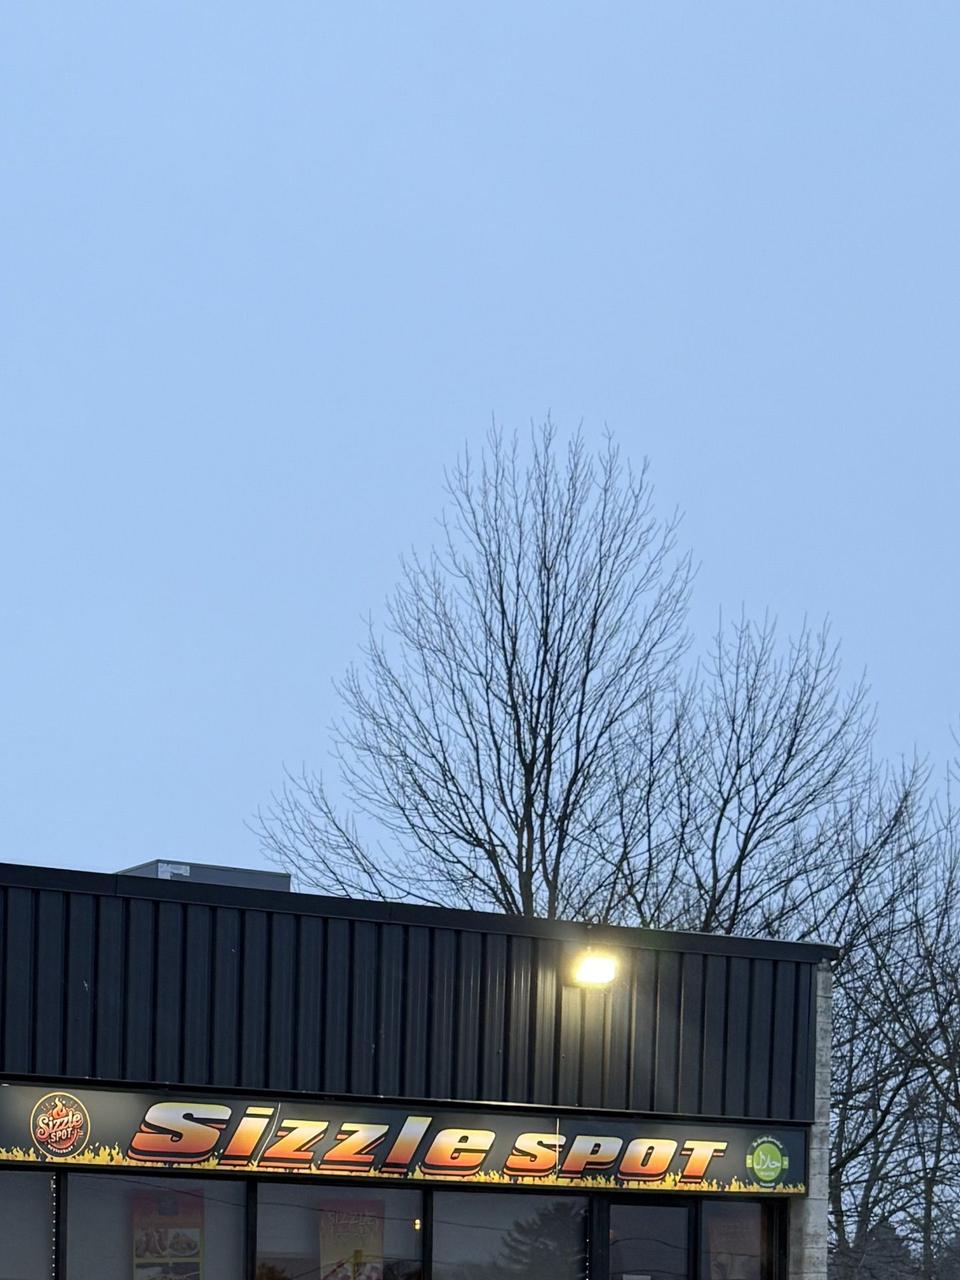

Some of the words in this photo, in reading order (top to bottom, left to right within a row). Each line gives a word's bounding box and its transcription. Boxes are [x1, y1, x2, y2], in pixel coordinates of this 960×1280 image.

[37, 1110, 83, 1134] Sizzle
[50, 1128, 73, 1142] SPOT
[128, 1102, 496, 1176] Sizzle
[503, 1132, 728, 1184] SPOT
